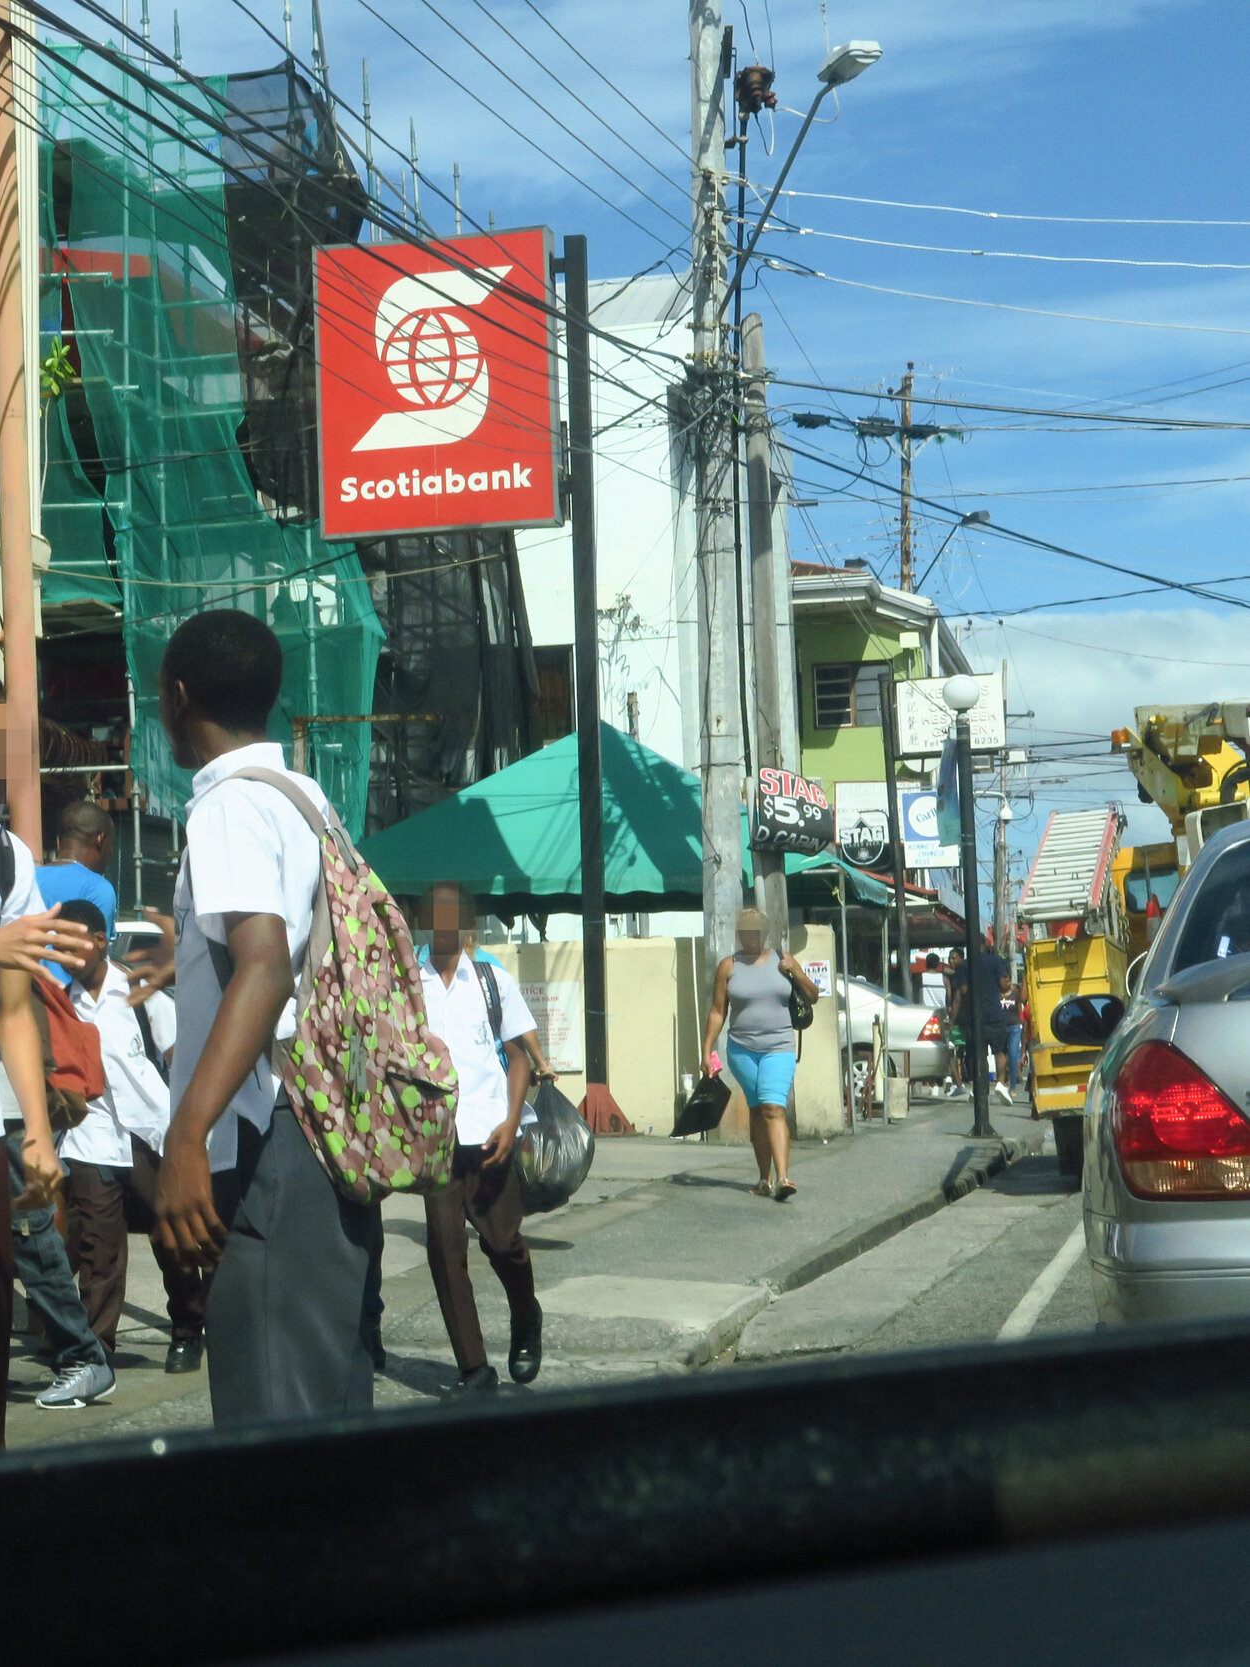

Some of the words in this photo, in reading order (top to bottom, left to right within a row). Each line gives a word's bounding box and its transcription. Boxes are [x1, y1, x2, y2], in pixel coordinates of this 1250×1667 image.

[340, 462, 532, 502] Scotiabank
[760, 768, 828, 810] STAG
[763, 795, 822, 827] $5.99
[840, 827, 884, 844] STAG
